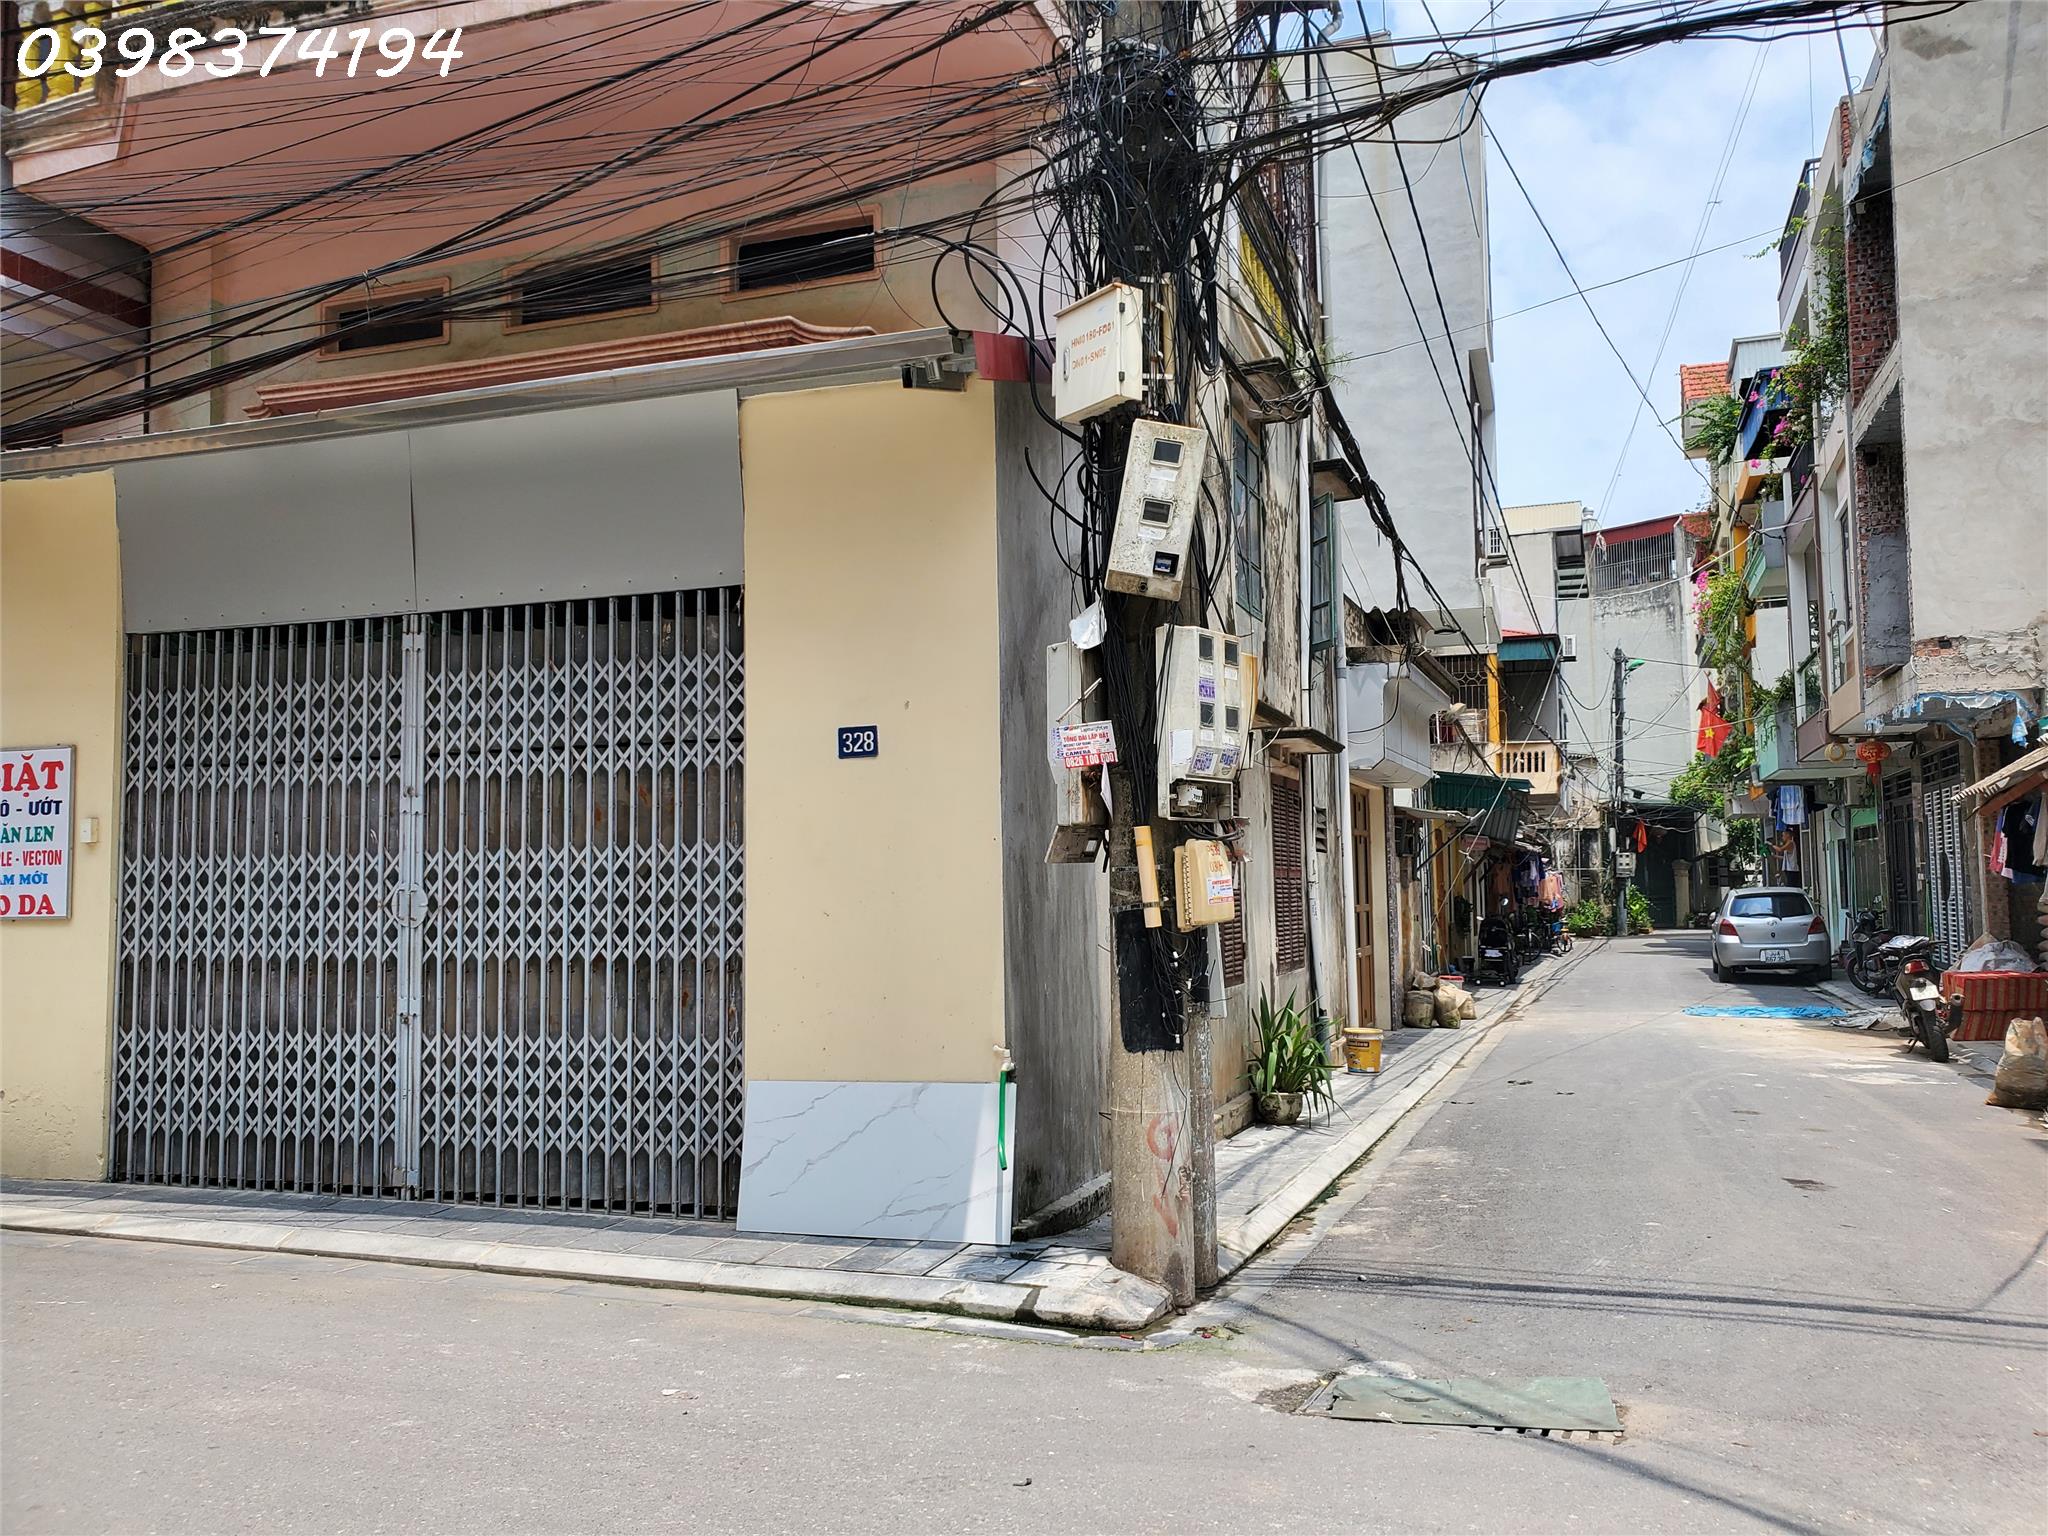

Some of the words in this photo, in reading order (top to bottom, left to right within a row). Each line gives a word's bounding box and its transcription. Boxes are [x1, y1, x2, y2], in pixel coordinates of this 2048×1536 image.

[842, 731, 875, 753] 328
[1066, 756, 1084, 768] 0826
[1085, 754, 1099, 765] 100
[0, 753, 64, 797] IẶT
[28, 796, 63, 816] ƯỚT
[25, 825, 55, 843] LEN
[22, 849, 62, 866] VECTON
[19, 870, 48, 885] MỚI
[18, 894, 55, 915] DA
